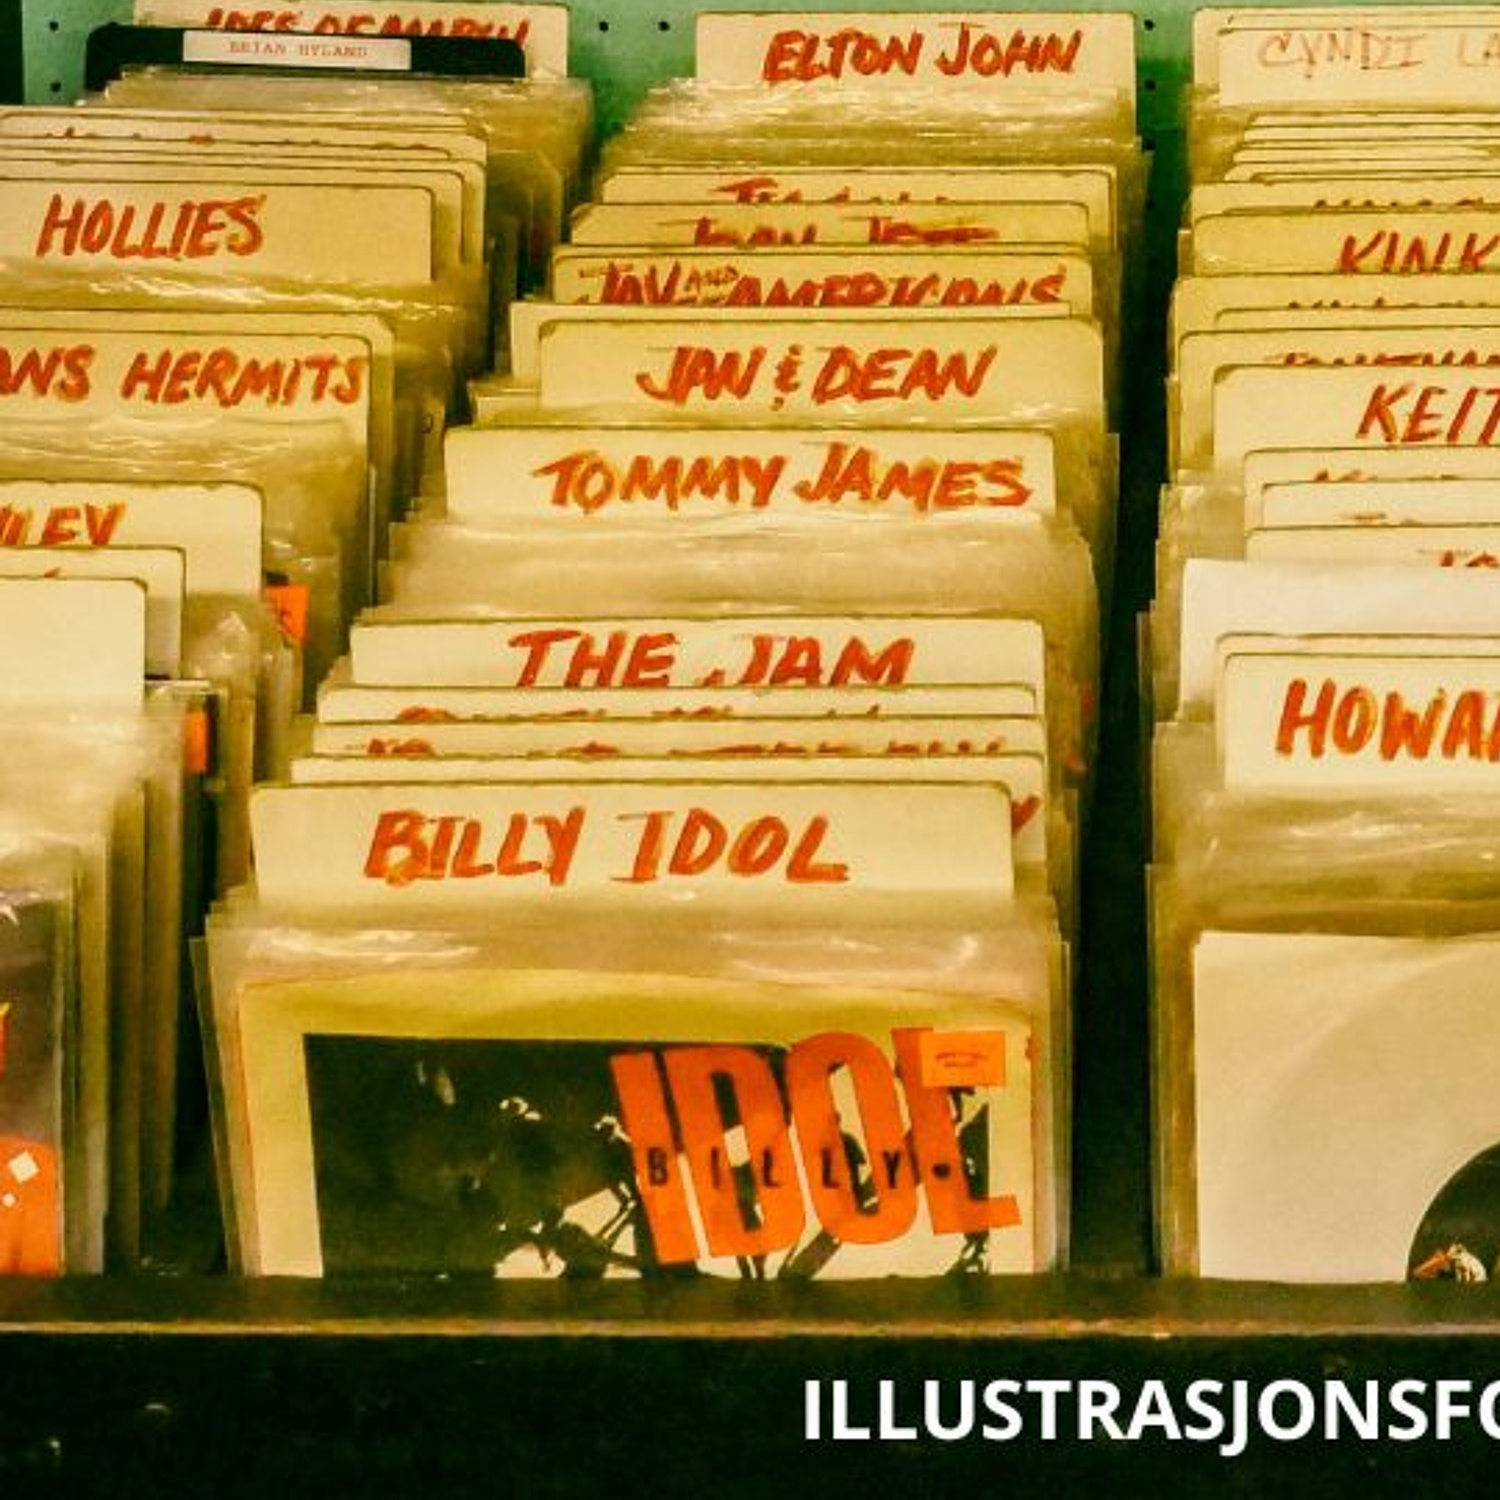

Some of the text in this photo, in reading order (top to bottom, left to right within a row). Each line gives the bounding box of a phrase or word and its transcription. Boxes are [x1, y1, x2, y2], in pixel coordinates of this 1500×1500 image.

[762, 20, 1082, 86] ELTON JOHN
[1257, 25, 1428, 78] CYNDI
[36, 193, 267, 260] HOLLIES
[121, 347, 370, 408] HERMITS
[635, 345, 767, 403] JAN
[810, 344, 998, 404] DEAN
[533, 441, 1036, 514] TOMMY JAMES
[507, 628, 917, 689] THE JAM
[363, 804, 850, 887] BILLY IDOL
[610, 1026, 1023, 1266] IDOL
[646, 1145, 900, 1190] BILLY
